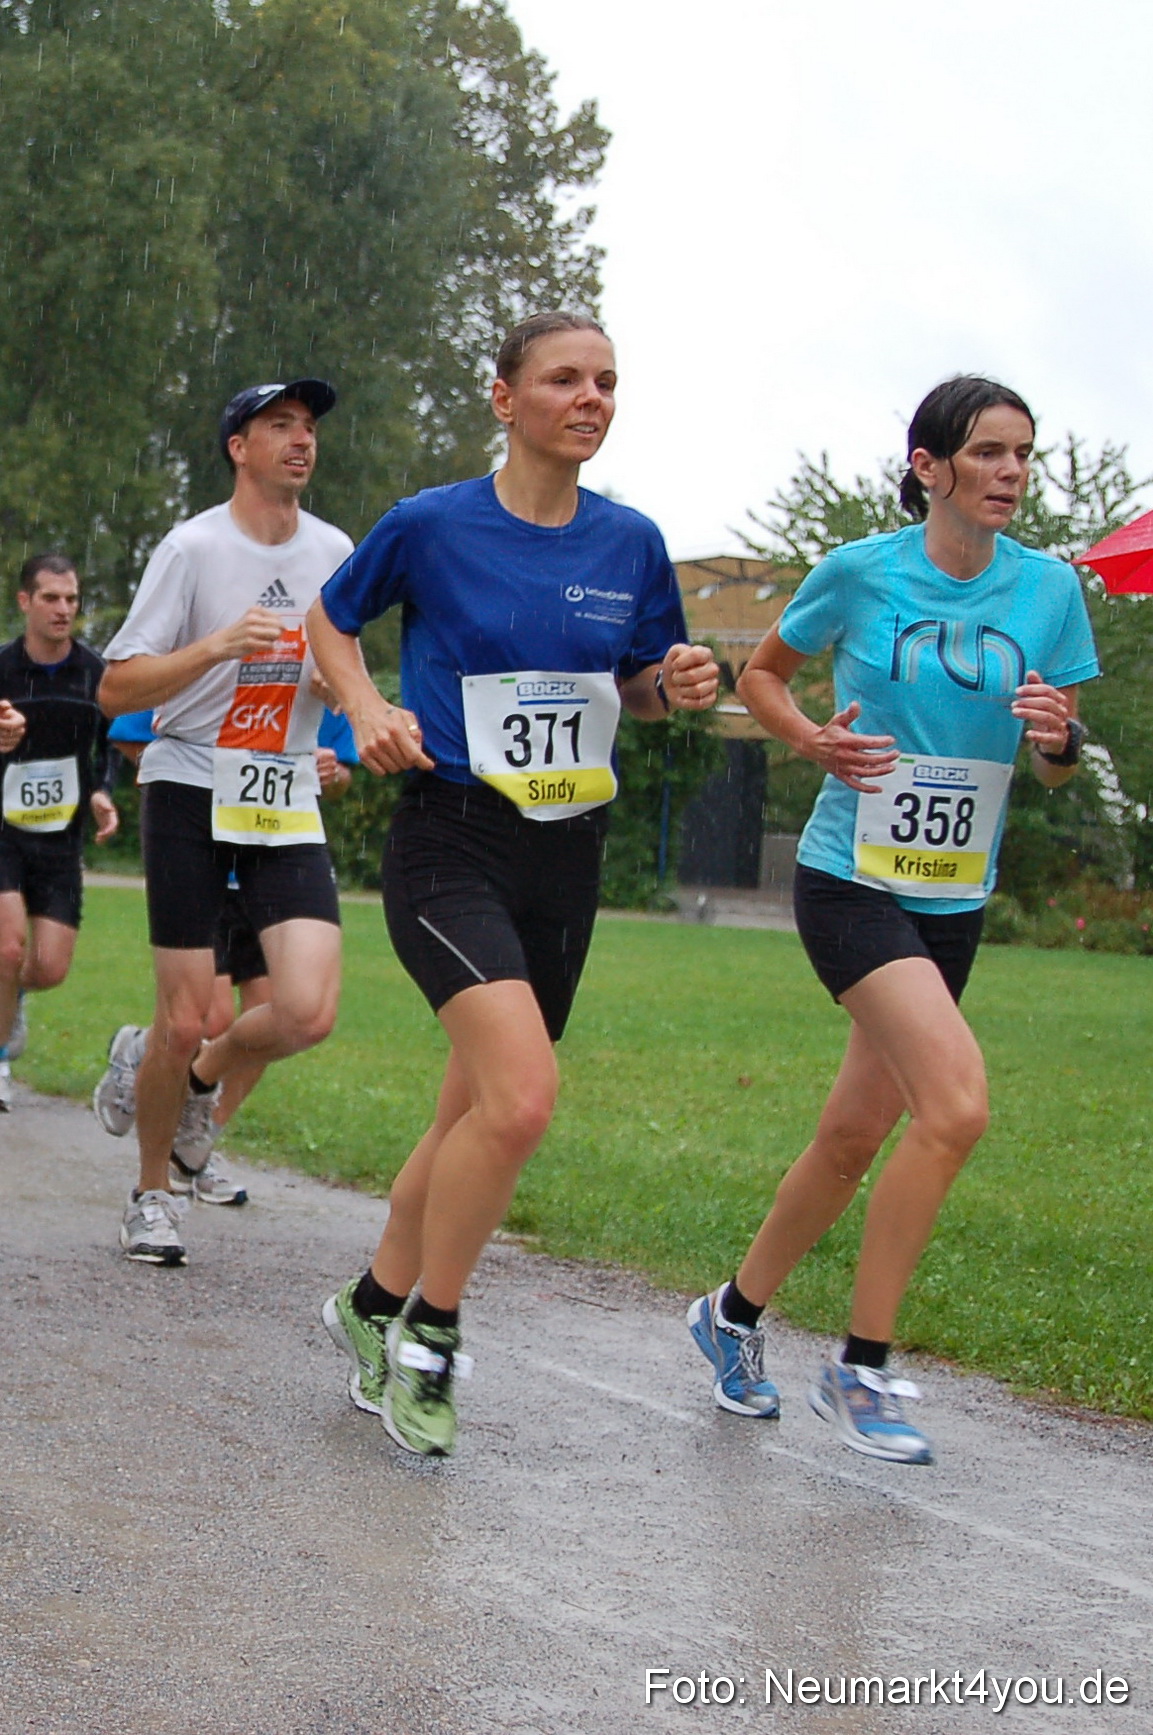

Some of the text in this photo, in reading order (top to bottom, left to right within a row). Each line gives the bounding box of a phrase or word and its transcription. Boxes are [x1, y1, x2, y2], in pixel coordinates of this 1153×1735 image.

[257, 597, 295, 608] adidas
[890, 613, 1026, 692] run
[517, 682, 576, 696] BOCK
[231, 704, 284, 732] GfK
[503, 711, 581, 767] 371
[239, 765, 294, 806] 261
[913, 765, 969, 781] BOCK
[20, 780, 63, 807] 653
[528, 778, 576, 803] Sindy
[890, 792, 975, 847] 358
[894, 855, 958, 878] Kristina
